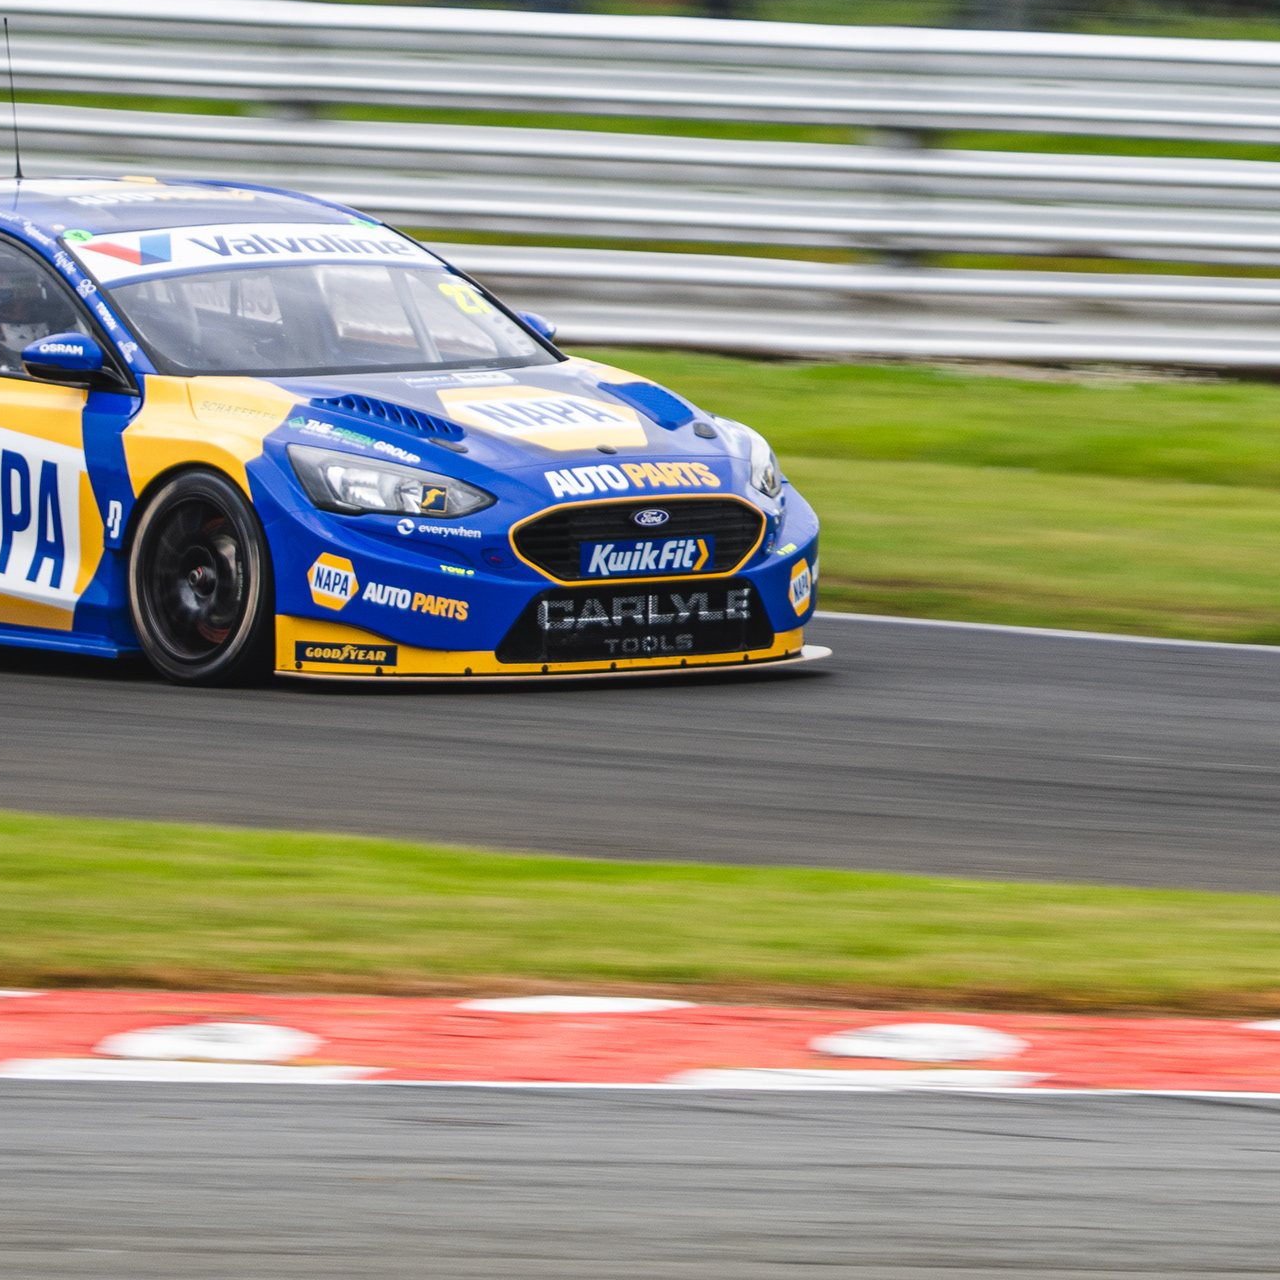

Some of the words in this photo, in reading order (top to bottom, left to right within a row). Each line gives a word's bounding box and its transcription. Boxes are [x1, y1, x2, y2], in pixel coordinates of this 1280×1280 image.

[187, 233, 417, 258] Valvoline
[39, 342, 84, 356] OSRAM
[200, 401, 277, 421] SCHAEFFLER
[466, 399, 624, 429] NAPA
[304, 419, 334, 435] THE
[332, 427, 376, 447] GREEN
[373, 440, 421, 463] GROUP
[544, 464, 630, 498] AUTO
[620, 462, 721, 488] PARTS
[418, 523, 482, 539] everywhen
[313, 566, 350, 597] NAPA
[440, 564, 465, 575] TOW
[792, 571, 810, 603] NAPA
[362, 581, 412, 610] AUTO
[411, 592, 469, 621] PARTS
[537, 588, 751, 630] CARLYLE
[305, 645, 387, 661] GOODYEAR
[604, 633, 694, 653] TOOLS
